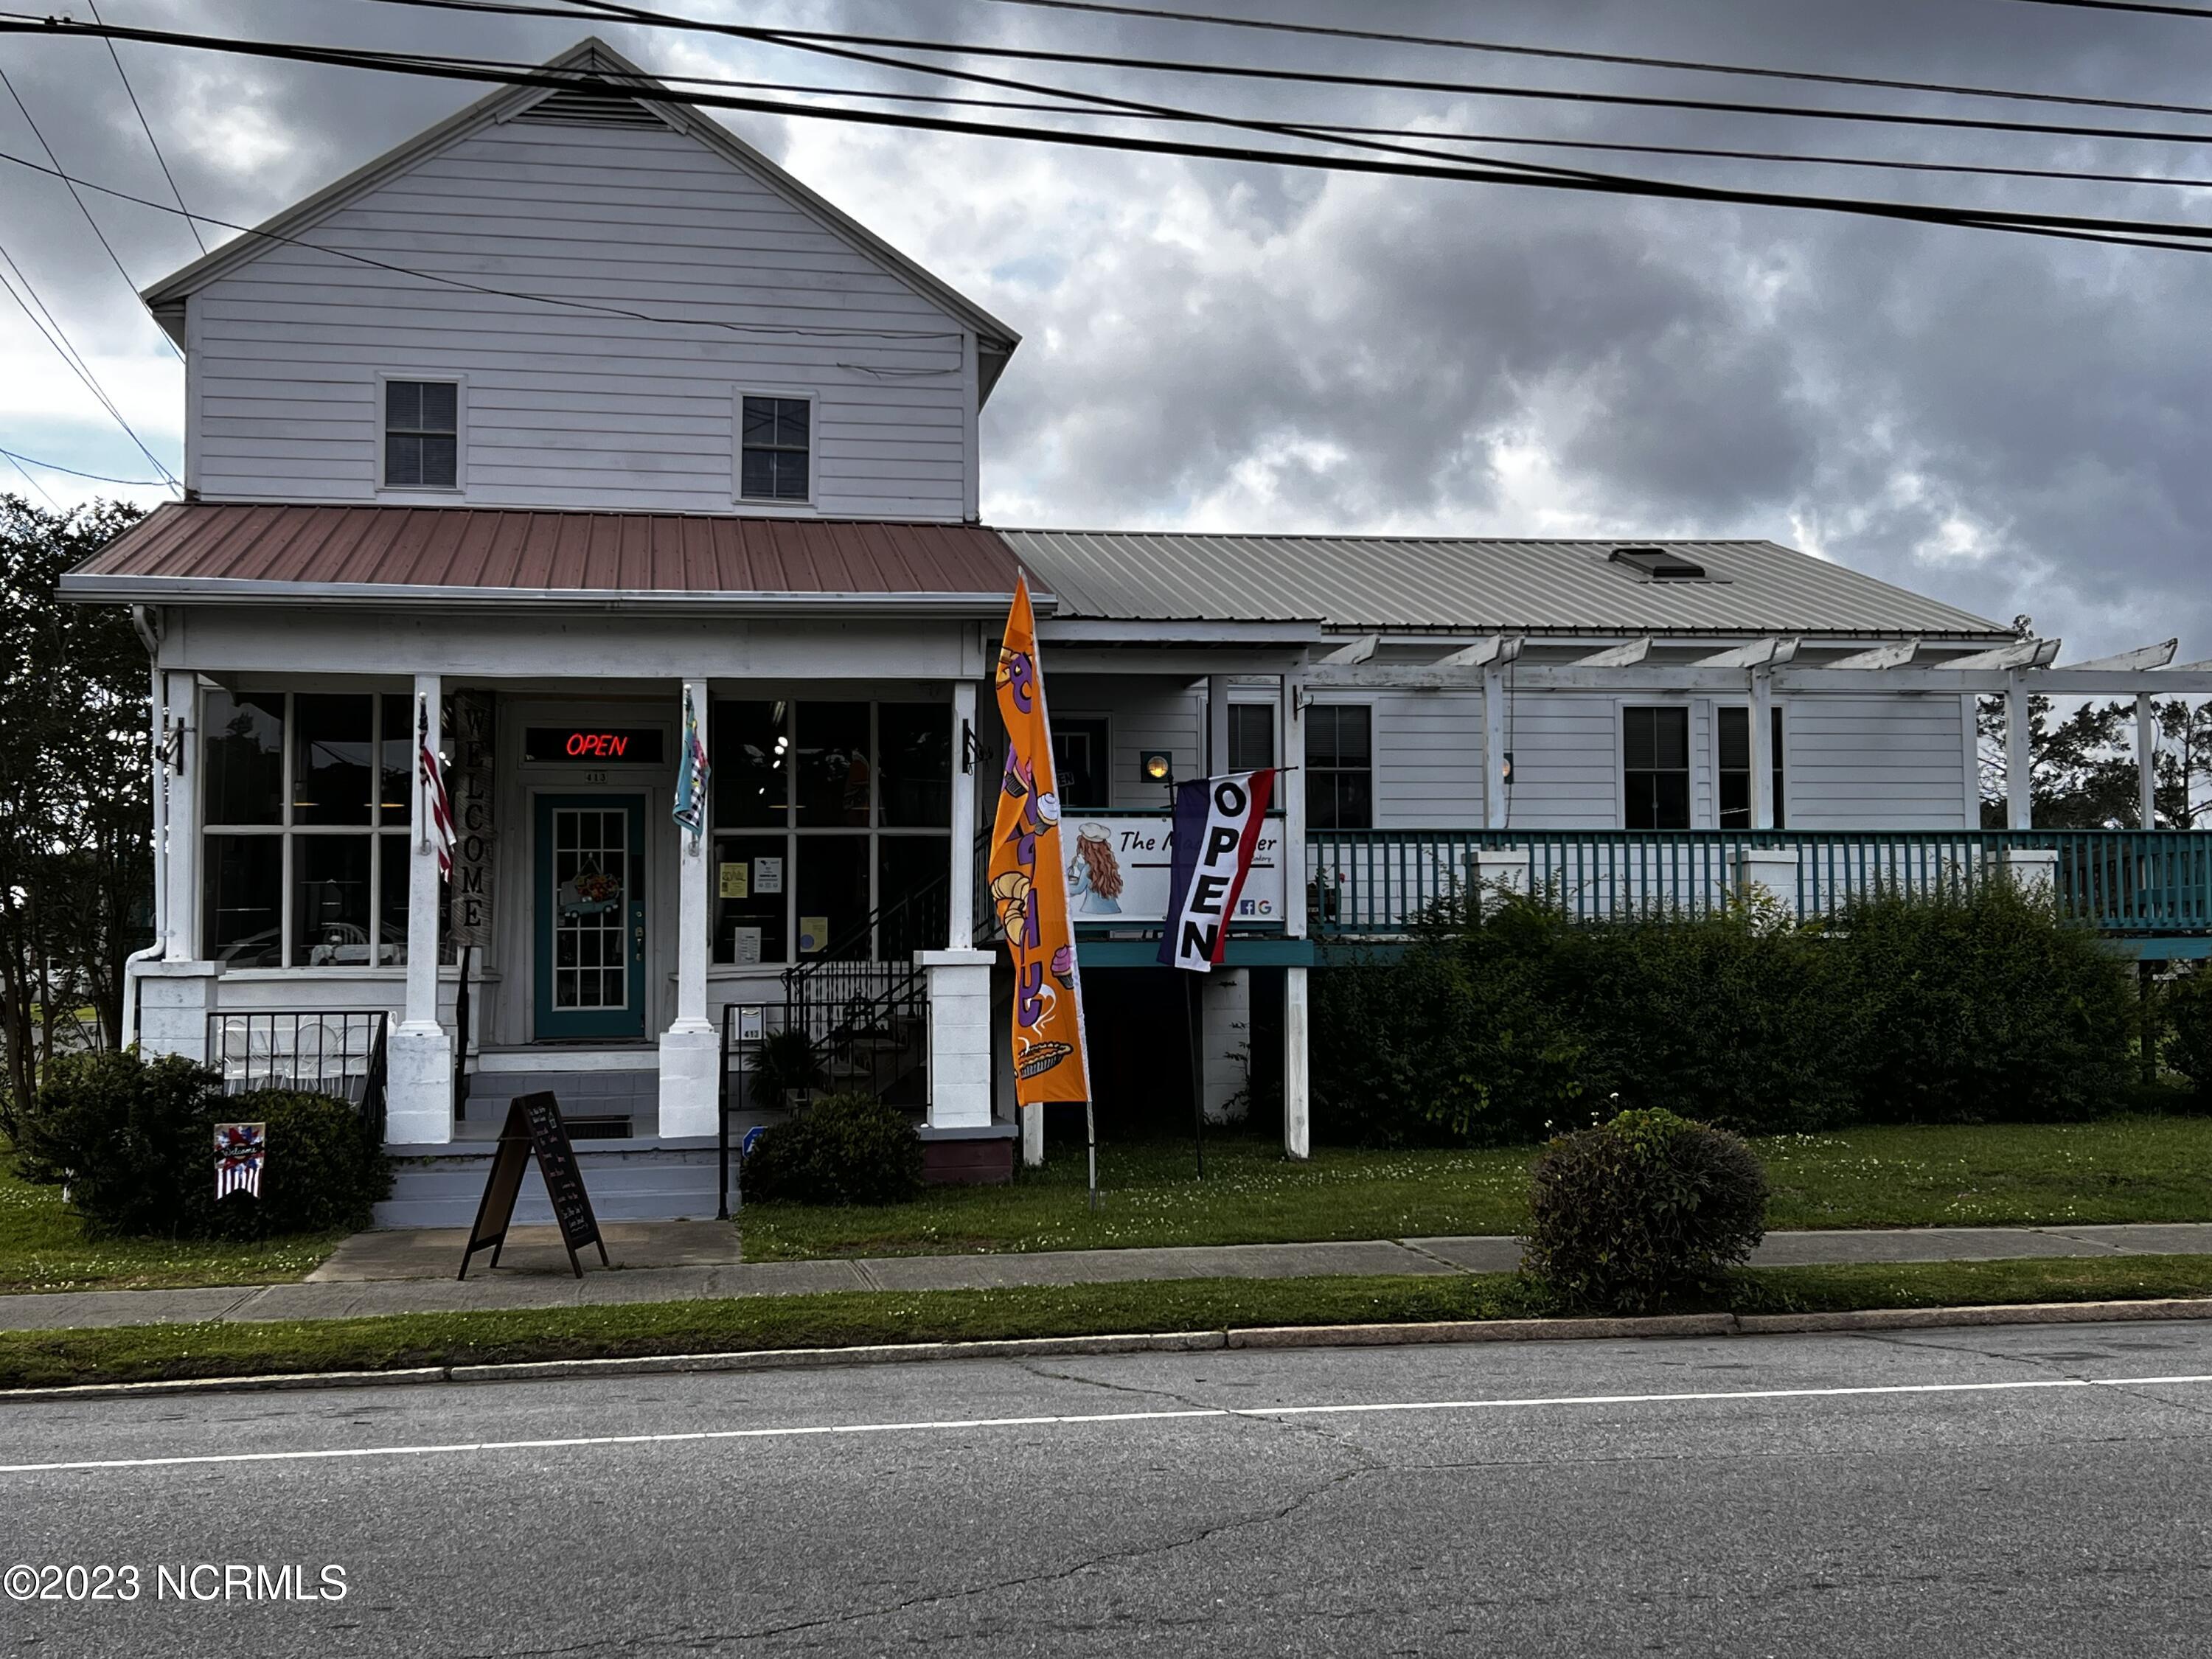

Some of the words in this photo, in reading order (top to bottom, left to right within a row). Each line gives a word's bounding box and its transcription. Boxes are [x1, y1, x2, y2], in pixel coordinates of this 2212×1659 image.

[566, 733, 627, 756] OPEN
[462, 708, 485, 927] WELCOME
[1121, 830, 1155, 852] The
[1180, 782, 1247, 962] OPEN
[745, 1030, 759, 1038] 413
